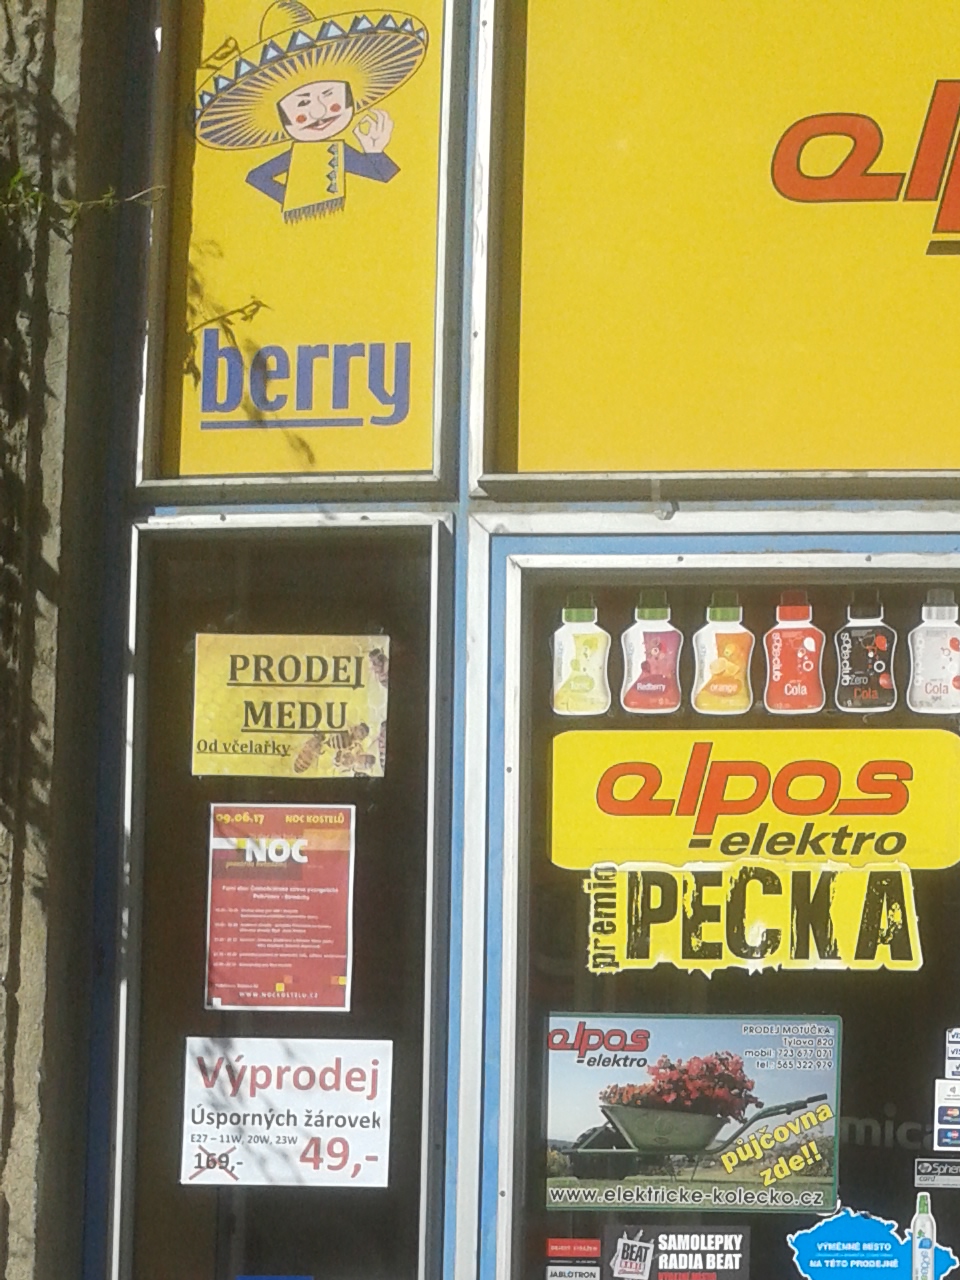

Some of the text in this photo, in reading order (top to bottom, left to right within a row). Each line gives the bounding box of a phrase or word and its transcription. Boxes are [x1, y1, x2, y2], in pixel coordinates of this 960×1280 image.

[200, 328, 412, 426] berry
[228, 653, 365, 690] PRODEJ
[849, 674, 869, 685] Zero
[784, 682, 808, 696] Cola
[853, 687, 879, 700] Cola
[924, 681, 949, 695] Cola
[241, 700, 348, 731] MEDU
[196, 737, 291, 758] Od včelařky
[215, 812, 265, 825] 09.06.17
[285, 814, 305, 824] NOC
[245, 837, 309, 864] NOC
[590, 866, 619, 969] premio
[626, 865, 914, 961] PECKA
[743, 1024, 780, 1035] PRODEJ
[783, 1037, 834, 1048] Tylova 820
[777, 1049, 795, 1058] 723
[796, 1049, 814, 1058] 677
[815, 1049, 833, 1058] 071
[776, 1060, 794, 1070] 565
[795, 1060, 813, 1070] 322
[815, 1060, 834, 1070] 979
[197, 1054, 380, 1101] Výprodej
[191, 1103, 381, 1130] Úsporných žárovek
[190, 1134, 298, 1146] E27 11W, 20W, 23W
[720, 1102, 834, 1175] půjčovna
[299, 1136, 379, 1179] 49,-
[759, 1140, 823, 1187] zde!!
[549, 1184, 825, 1207] www.elektricke-kolecko.cz
[657, 1233, 744, 1251] SAMOLEPKY
[621, 1242, 650, 1262] BEAT
[657, 1253, 704, 1270] RADIA
[706, 1253, 743, 1270] BEAT
[824, 1258, 848, 1268] TÉTO
[850, 1258, 899, 1269] PRODEJNĚ
[549, 1271, 597, 1279] JABLOTRON
